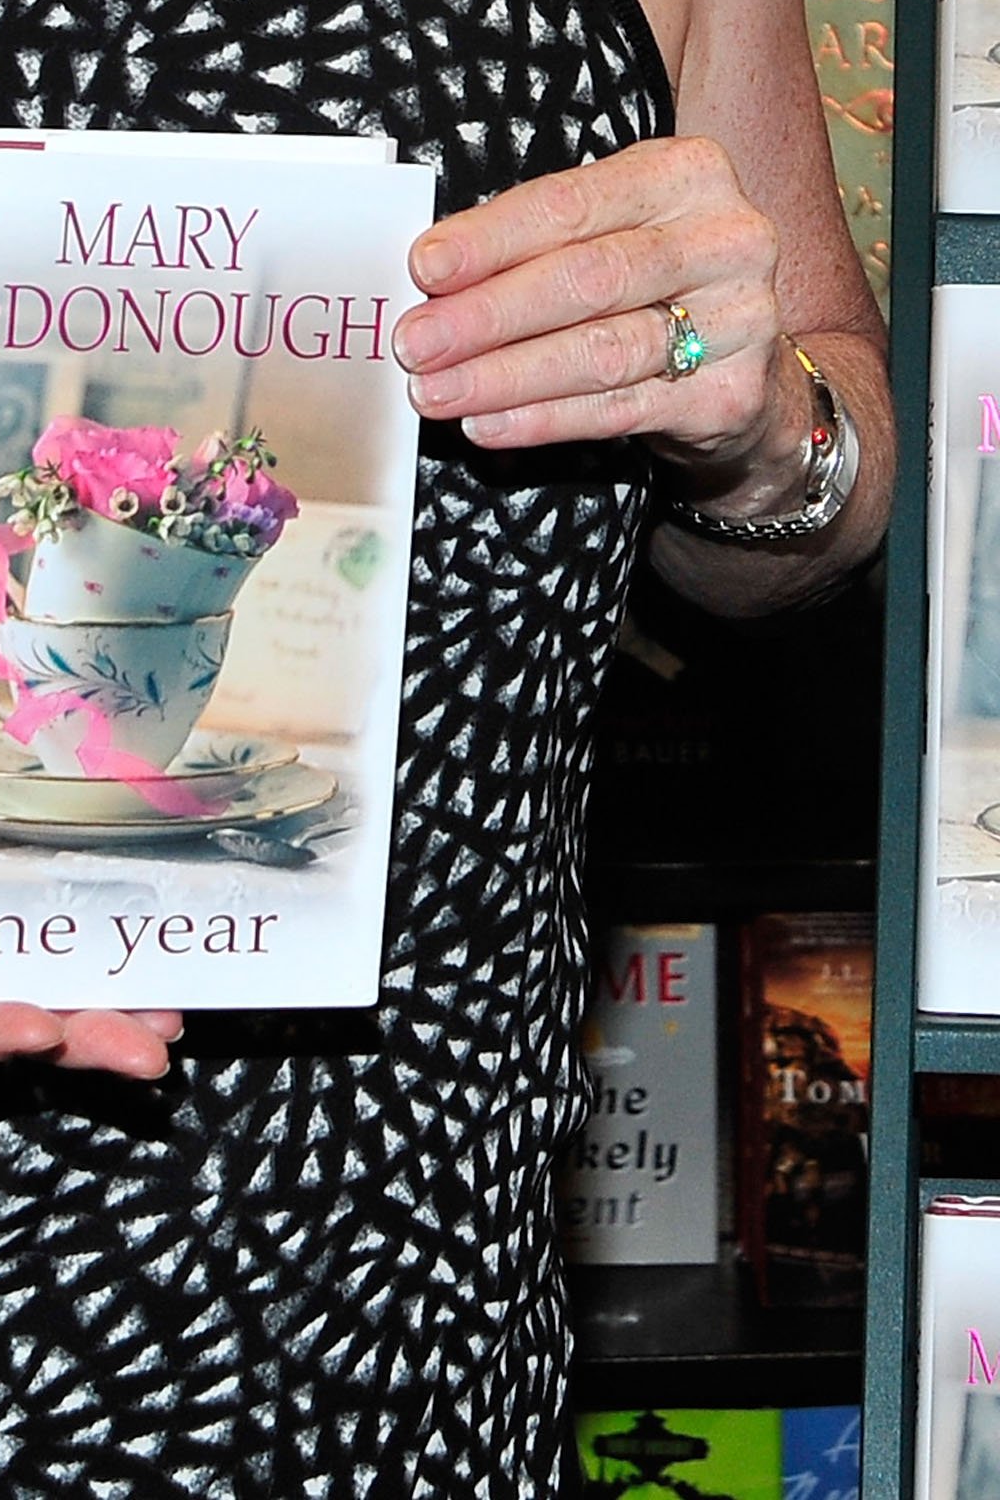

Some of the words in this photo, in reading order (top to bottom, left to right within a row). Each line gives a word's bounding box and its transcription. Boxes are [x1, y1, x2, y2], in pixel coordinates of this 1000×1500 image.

[54, 200, 260, 272] MARY
[107, 913, 279, 976] year
[591, 1075, 648, 1116] he
[577, 1130, 679, 1183] kely
[567, 1190, 643, 1226] ent
